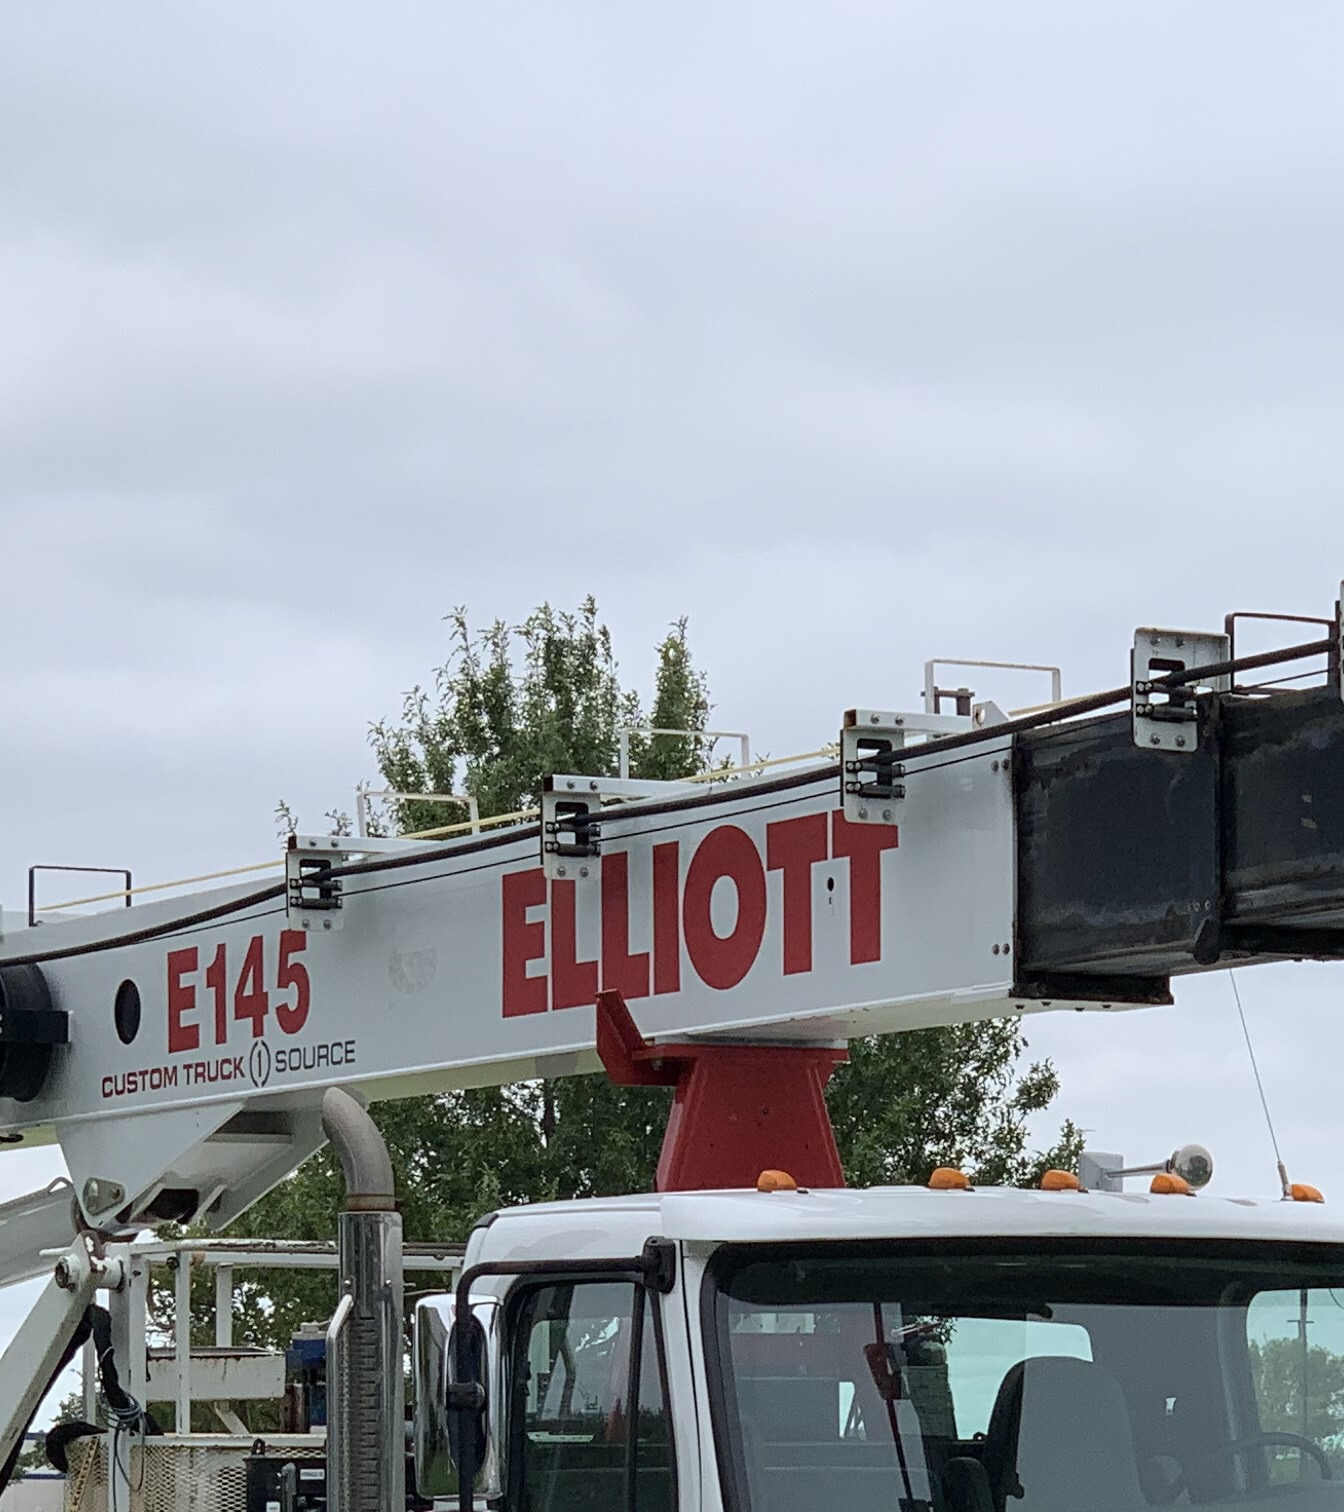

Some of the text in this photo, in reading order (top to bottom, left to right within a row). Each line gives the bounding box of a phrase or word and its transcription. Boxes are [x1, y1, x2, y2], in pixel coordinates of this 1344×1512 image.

[502, 808, 900, 1018] ELLIOTT
[167, 929, 311, 1054] E145
[101, 1065, 179, 1099] CUSTOM
[182, 1055, 246, 1086] TRUCK
[274, 1040, 357, 1073] SOURCE
